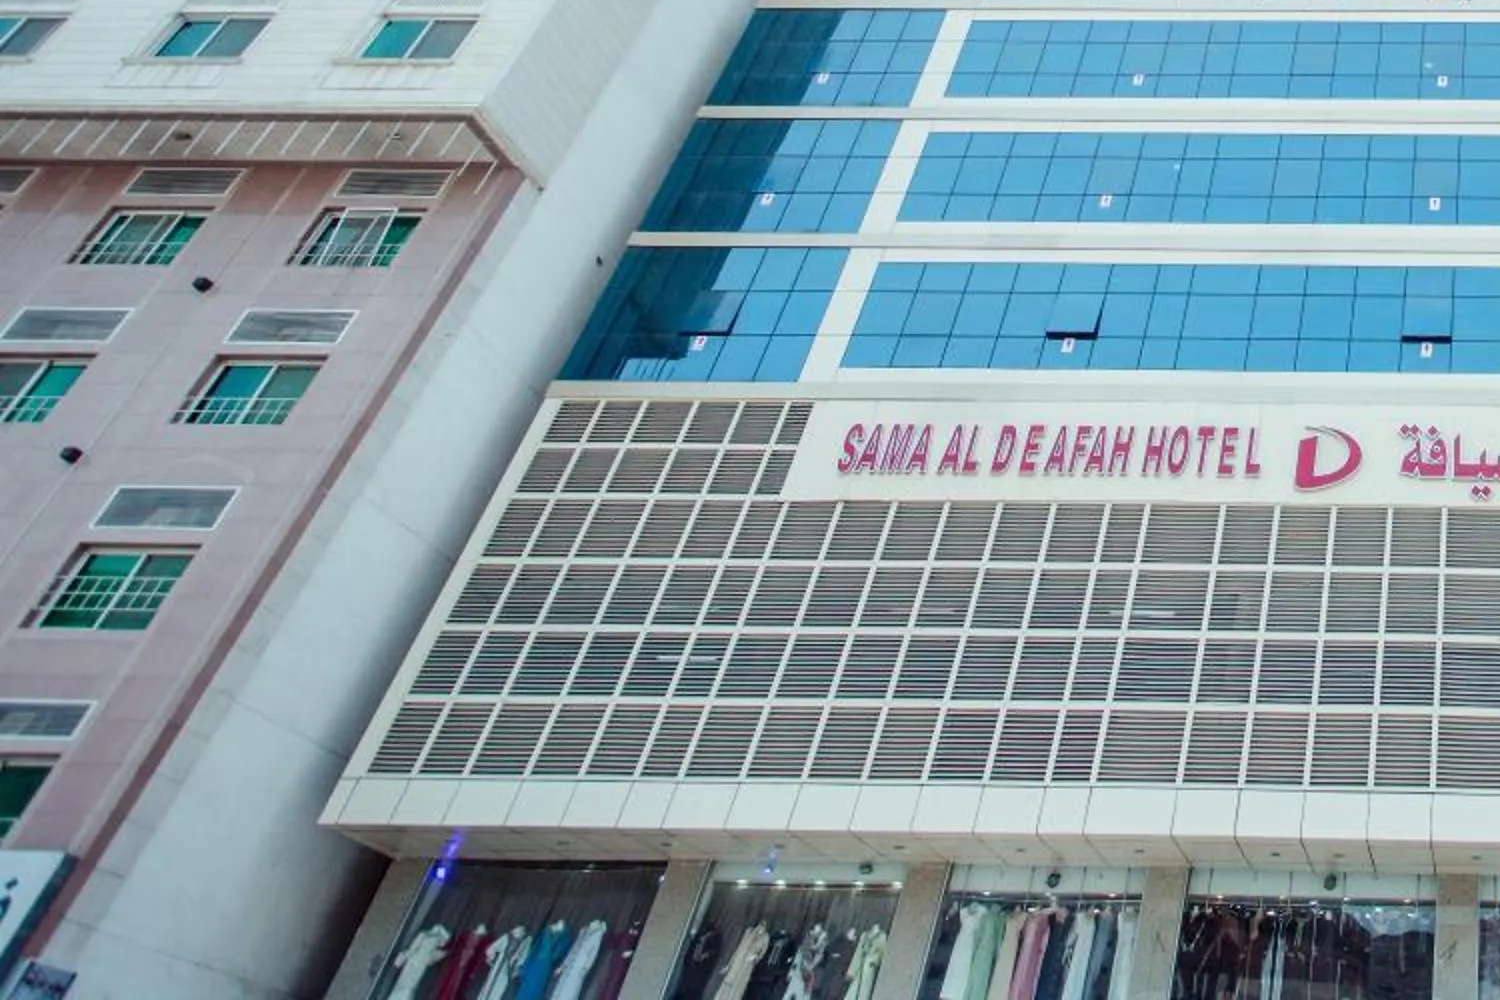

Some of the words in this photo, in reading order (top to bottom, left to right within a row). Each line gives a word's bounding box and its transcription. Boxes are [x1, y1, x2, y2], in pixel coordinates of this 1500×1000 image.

[837, 423, 933, 474] SAMA
[938, 424, 979, 474] AL
[990, 424, 1134, 476] DEAFAH
[1141, 426, 1261, 476] HOTEL
